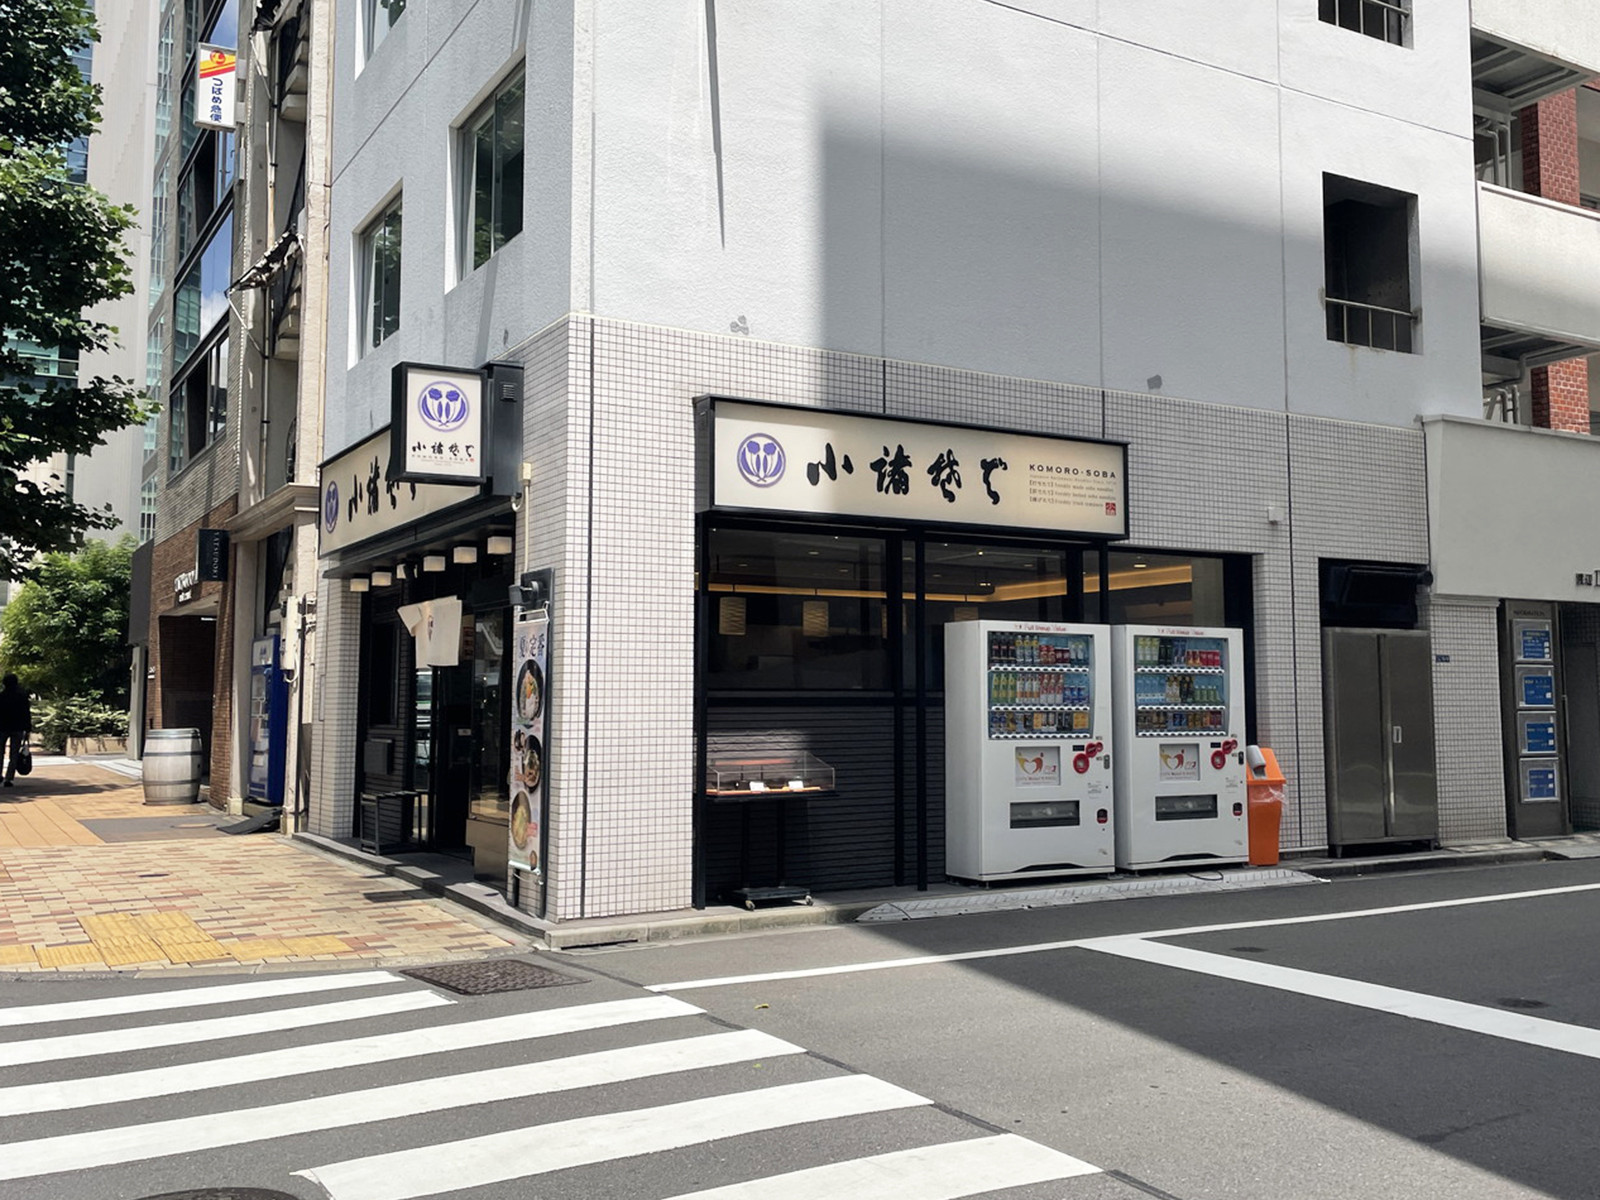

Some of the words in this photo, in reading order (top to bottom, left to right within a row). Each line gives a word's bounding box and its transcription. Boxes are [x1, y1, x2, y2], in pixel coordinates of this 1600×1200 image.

[210, 78, 223, 123] つばめ急便
